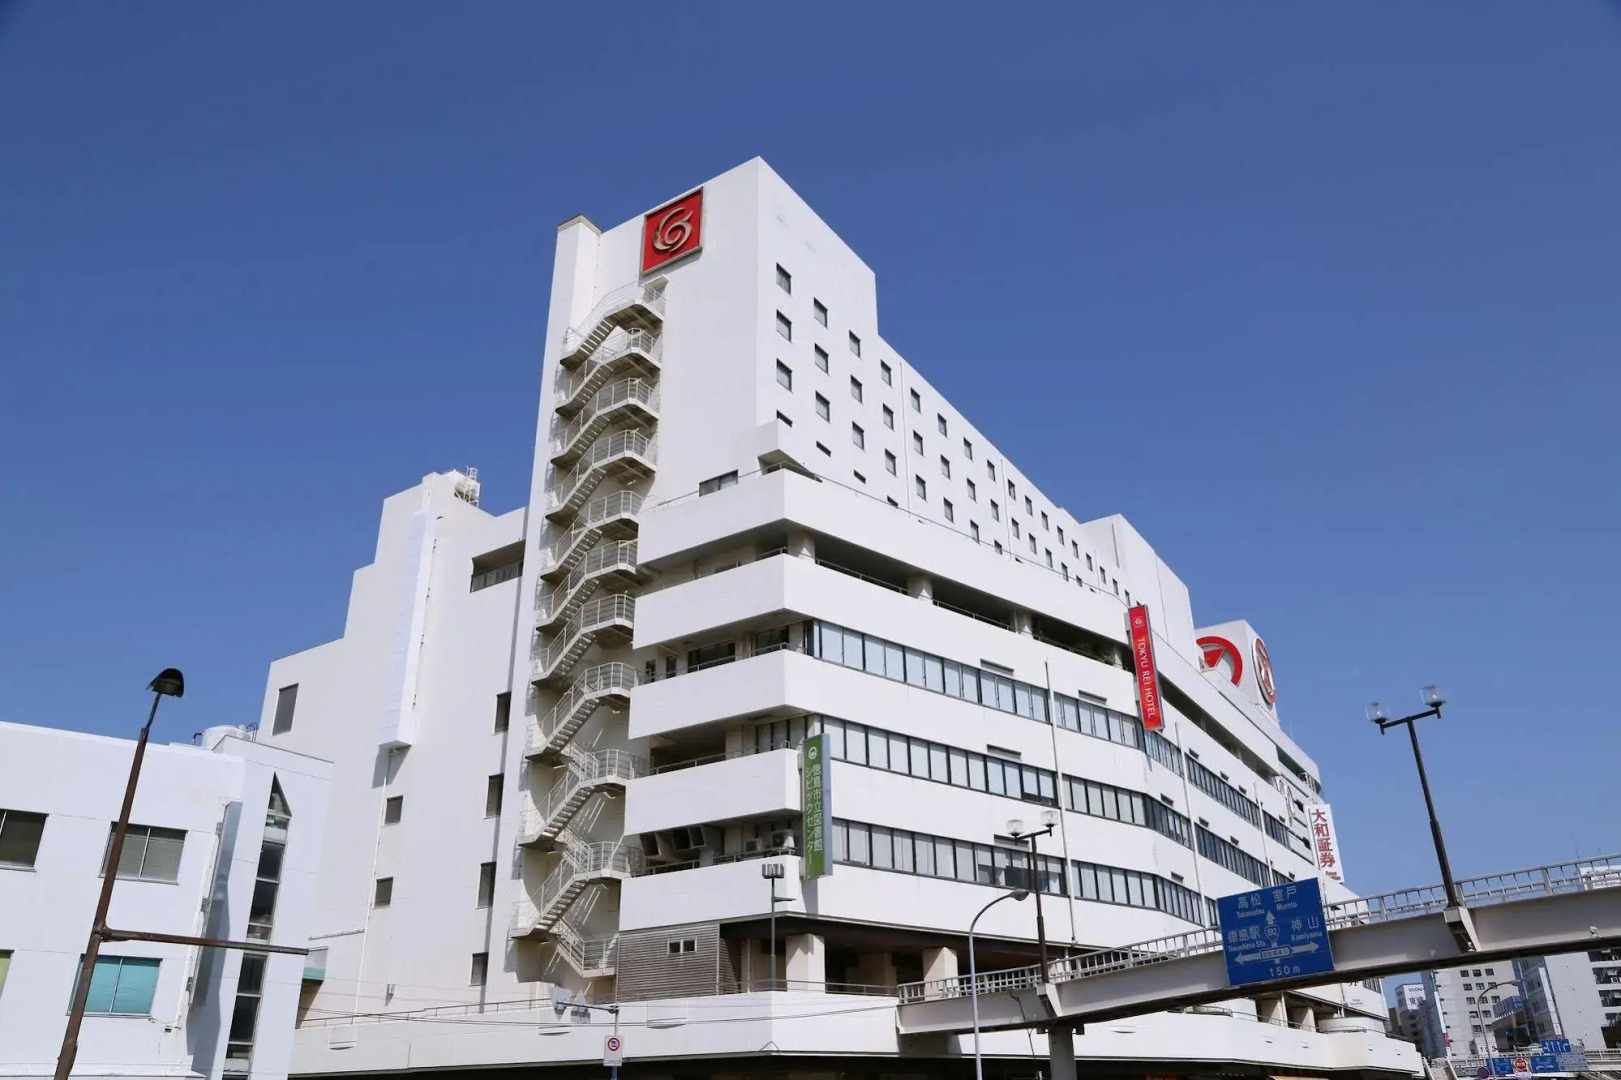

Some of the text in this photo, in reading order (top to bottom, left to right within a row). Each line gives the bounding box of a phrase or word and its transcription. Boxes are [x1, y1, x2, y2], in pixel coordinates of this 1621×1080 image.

[1137, 637, 1156, 719] TOKYU REI HOTEL
[805, 767, 814, 865] シビックセンター
[813, 763, 823, 852] 徳島市立図書館
[1311, 808, 1336, 868] 大和証券
[1237, 893, 1262, 909] 高松
[1272, 885, 1297, 902] 室戸
[1291, 915, 1320, 932] 神山
[1228, 926, 1261, 943] 徳島駅
[1290, 931, 1323, 942] Kamiyama
[1268, 965, 1301, 977] 150 m
